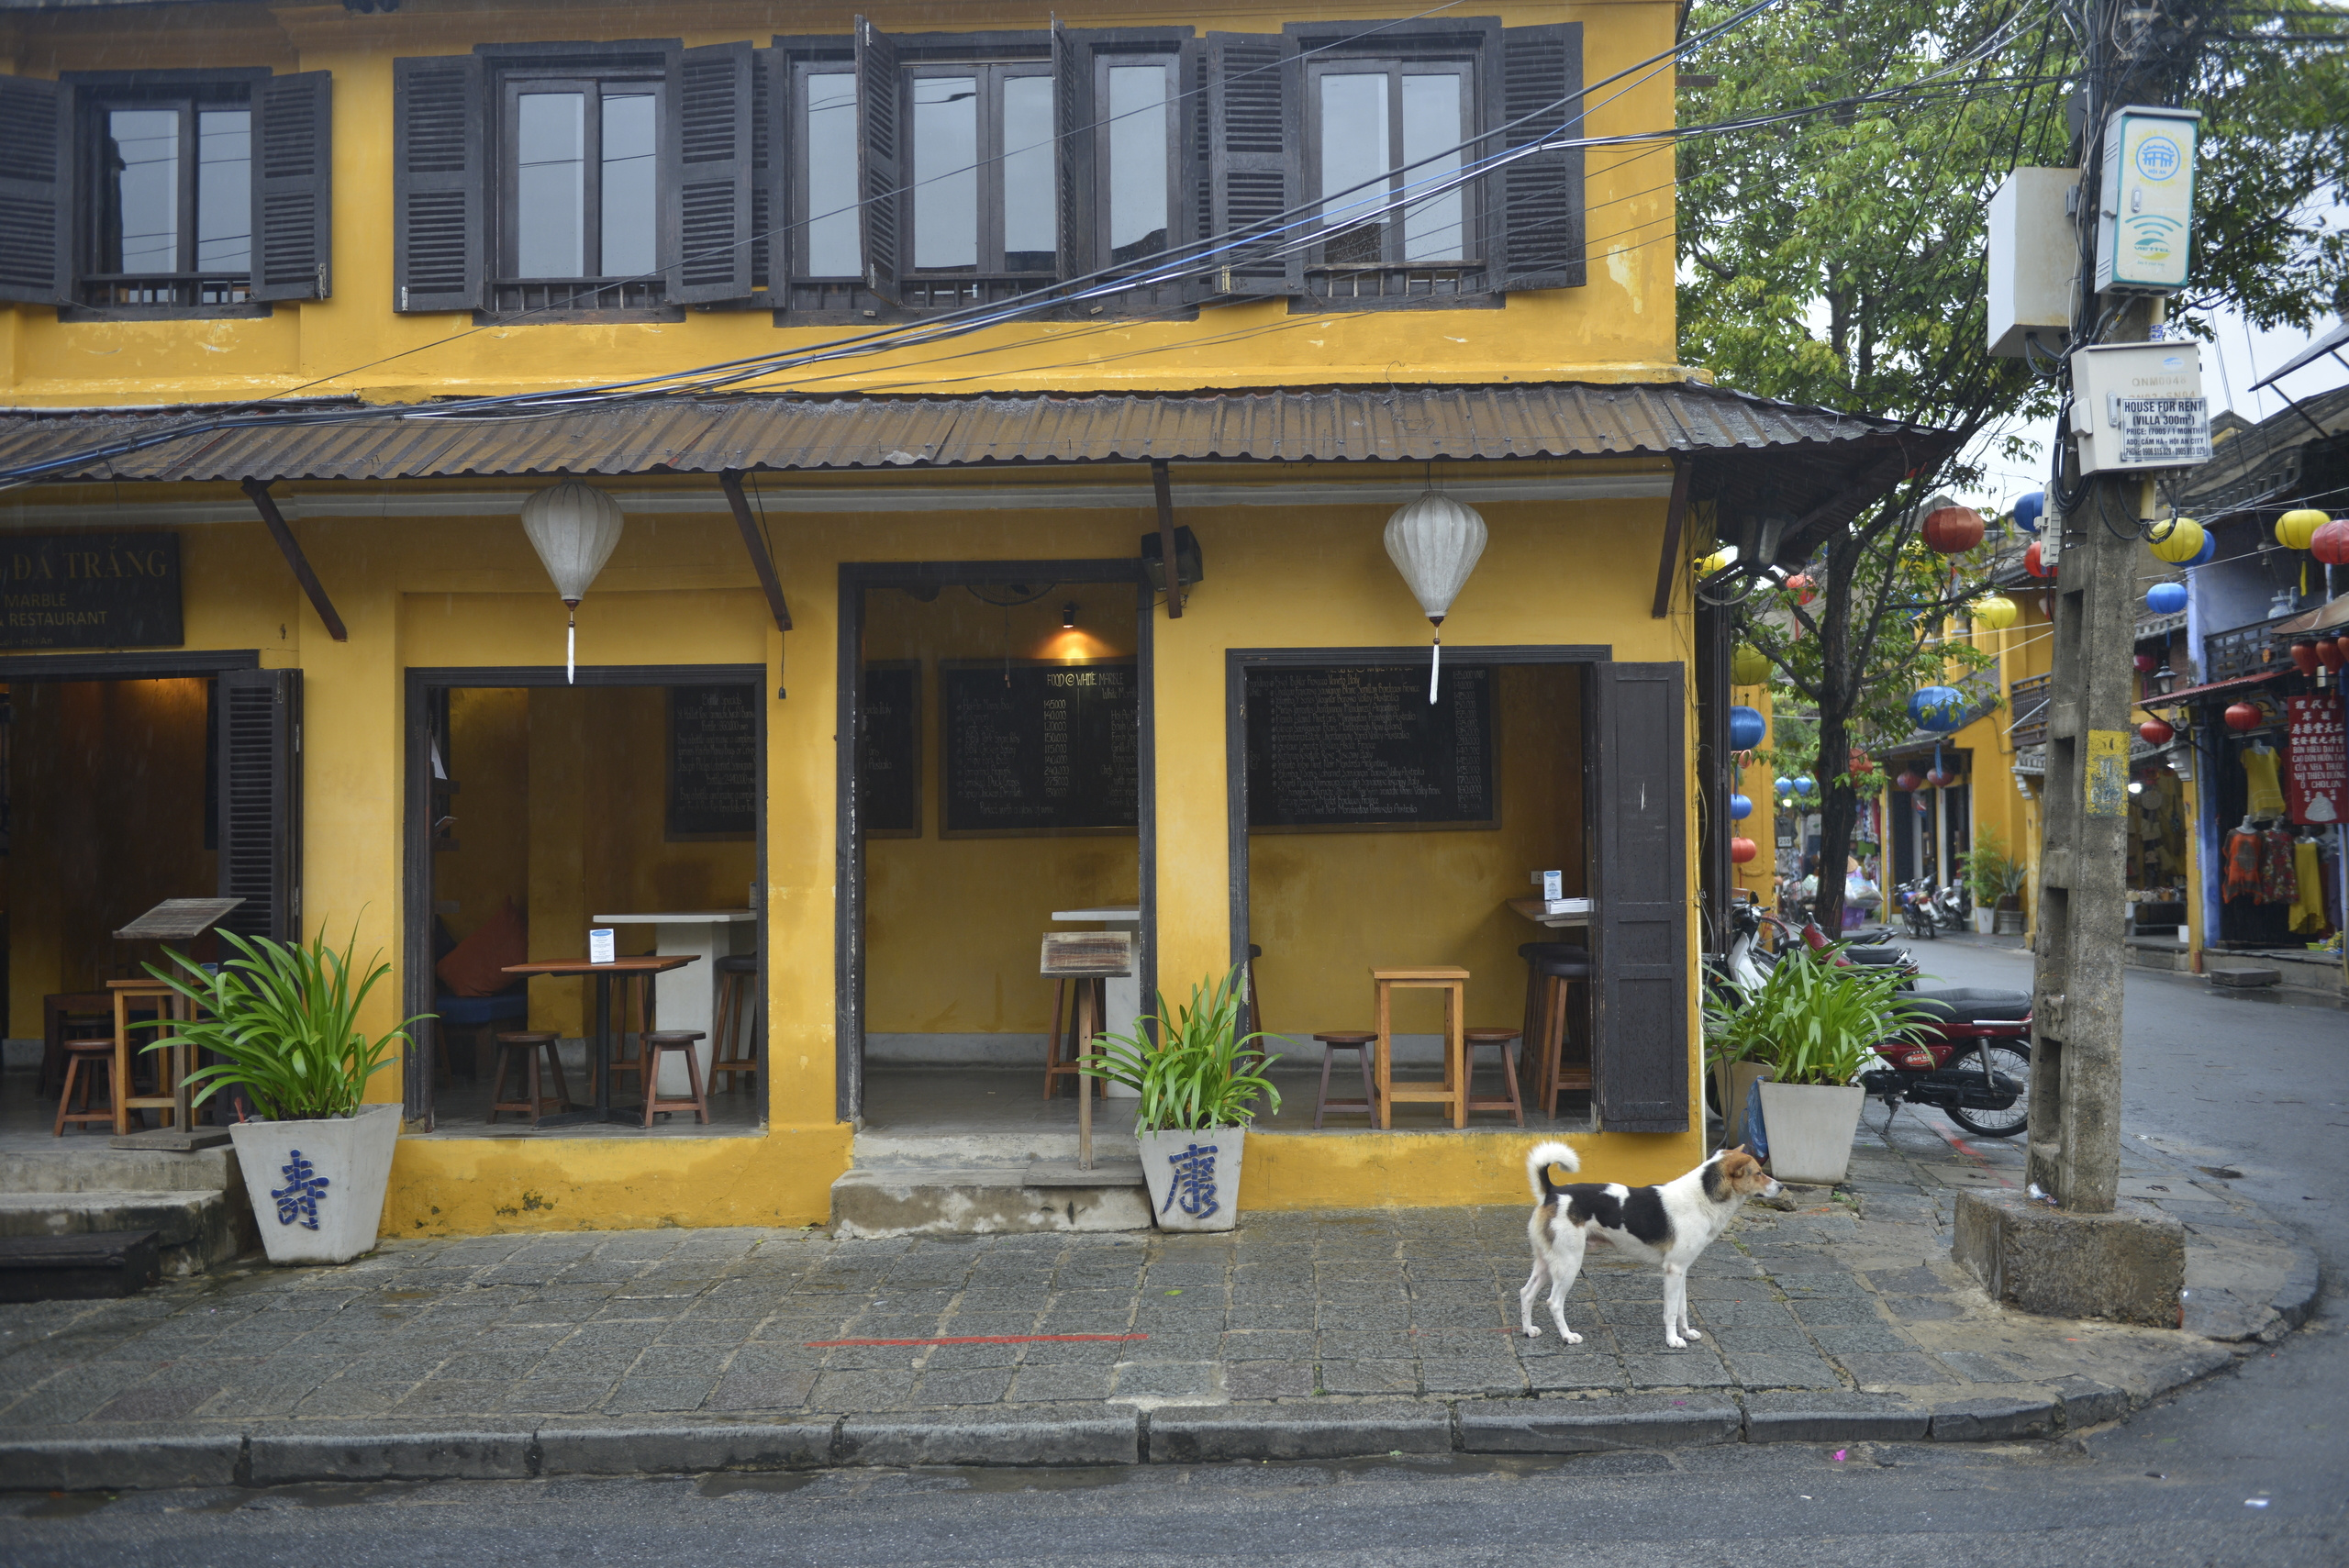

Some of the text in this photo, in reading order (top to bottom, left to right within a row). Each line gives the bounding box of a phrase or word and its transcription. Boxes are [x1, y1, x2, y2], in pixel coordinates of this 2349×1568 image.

[2124, 400, 2204, 413] HOUSE FOR RENT
[2132, 415, 2161, 427] (VILLA
[2126, 428, 2147, 436] PRICE:
[2177, 427, 2203, 436] MONTH)
[12, 544, 54, 581] ĐÁ
[5, 593, 67, 607] MARBLE
[9, 611, 108, 627] RESTAURANT
[1098, 672, 1124, 686] MARBLE
